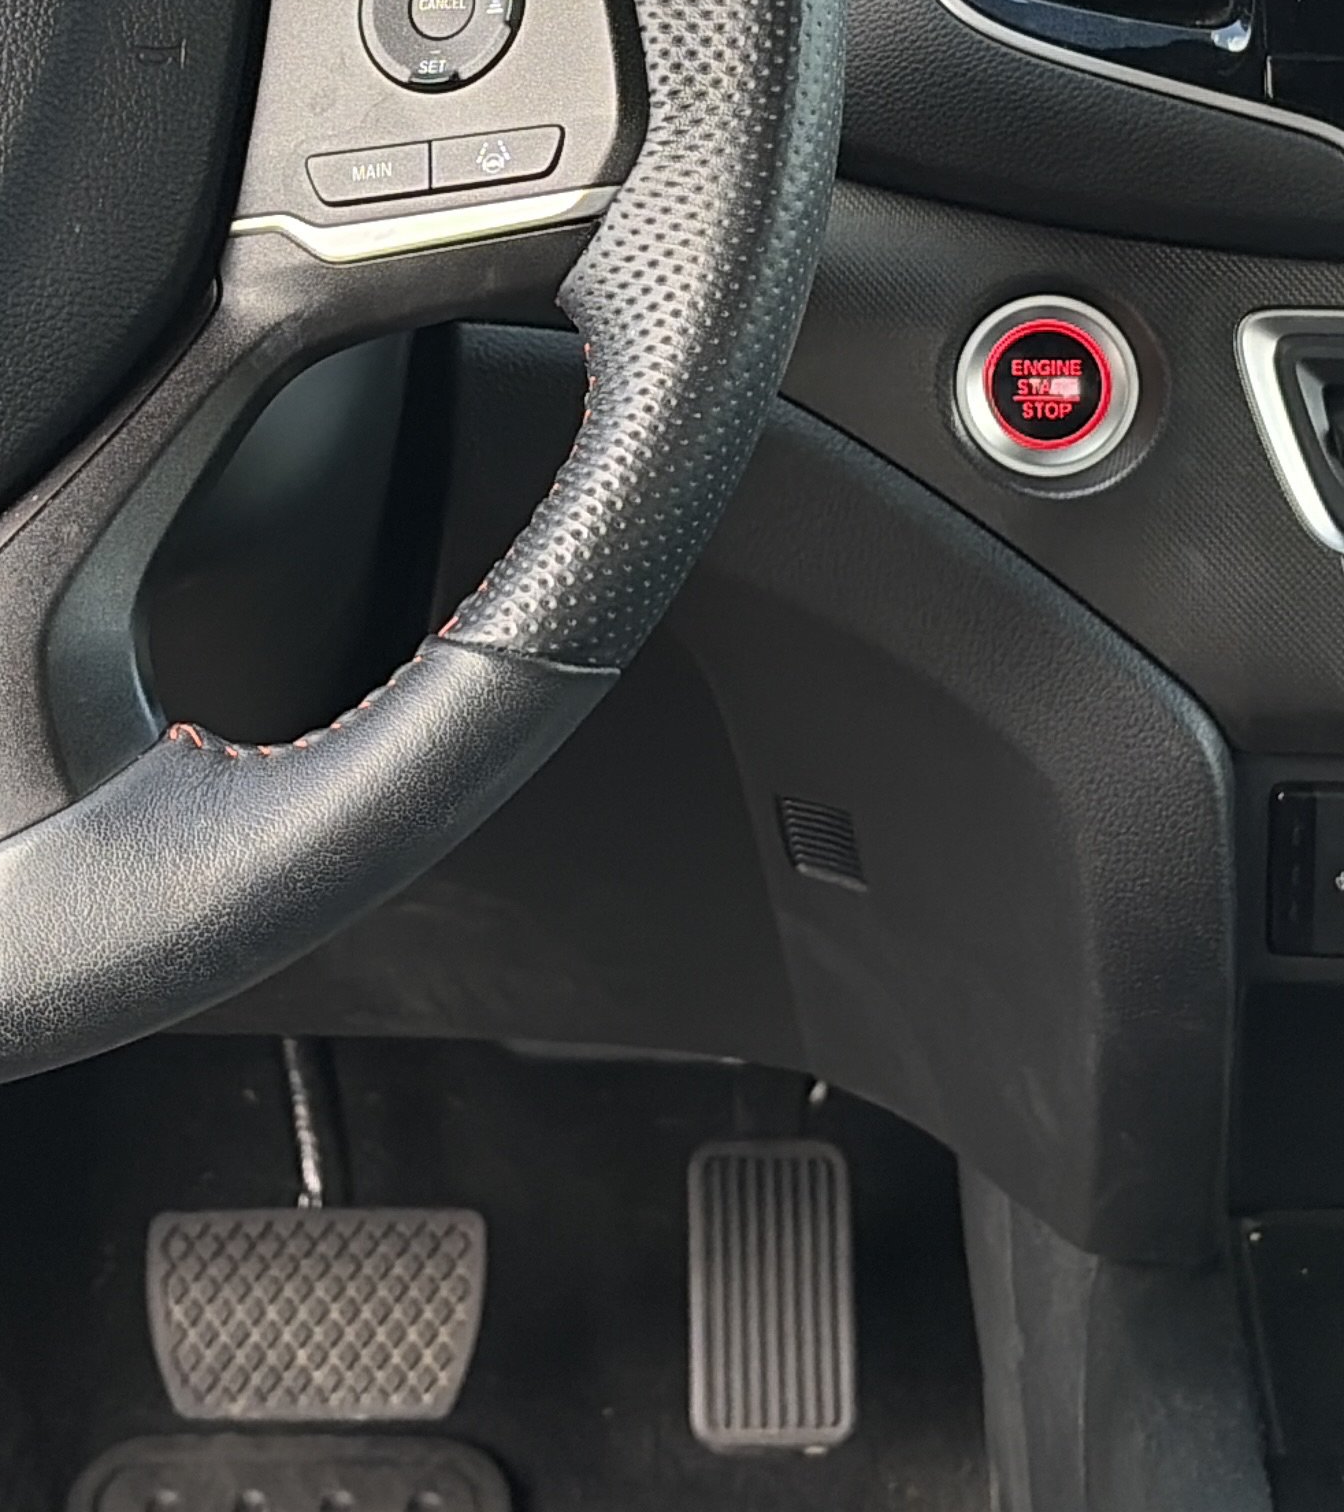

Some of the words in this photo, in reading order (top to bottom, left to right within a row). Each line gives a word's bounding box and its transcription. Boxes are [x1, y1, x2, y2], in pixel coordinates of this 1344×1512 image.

[418, 59, 447, 75] SET
[351, 162, 393, 182] MAIN
[1011, 359, 1083, 376] ENGINE
[1022, 402, 1073, 420] STOP
